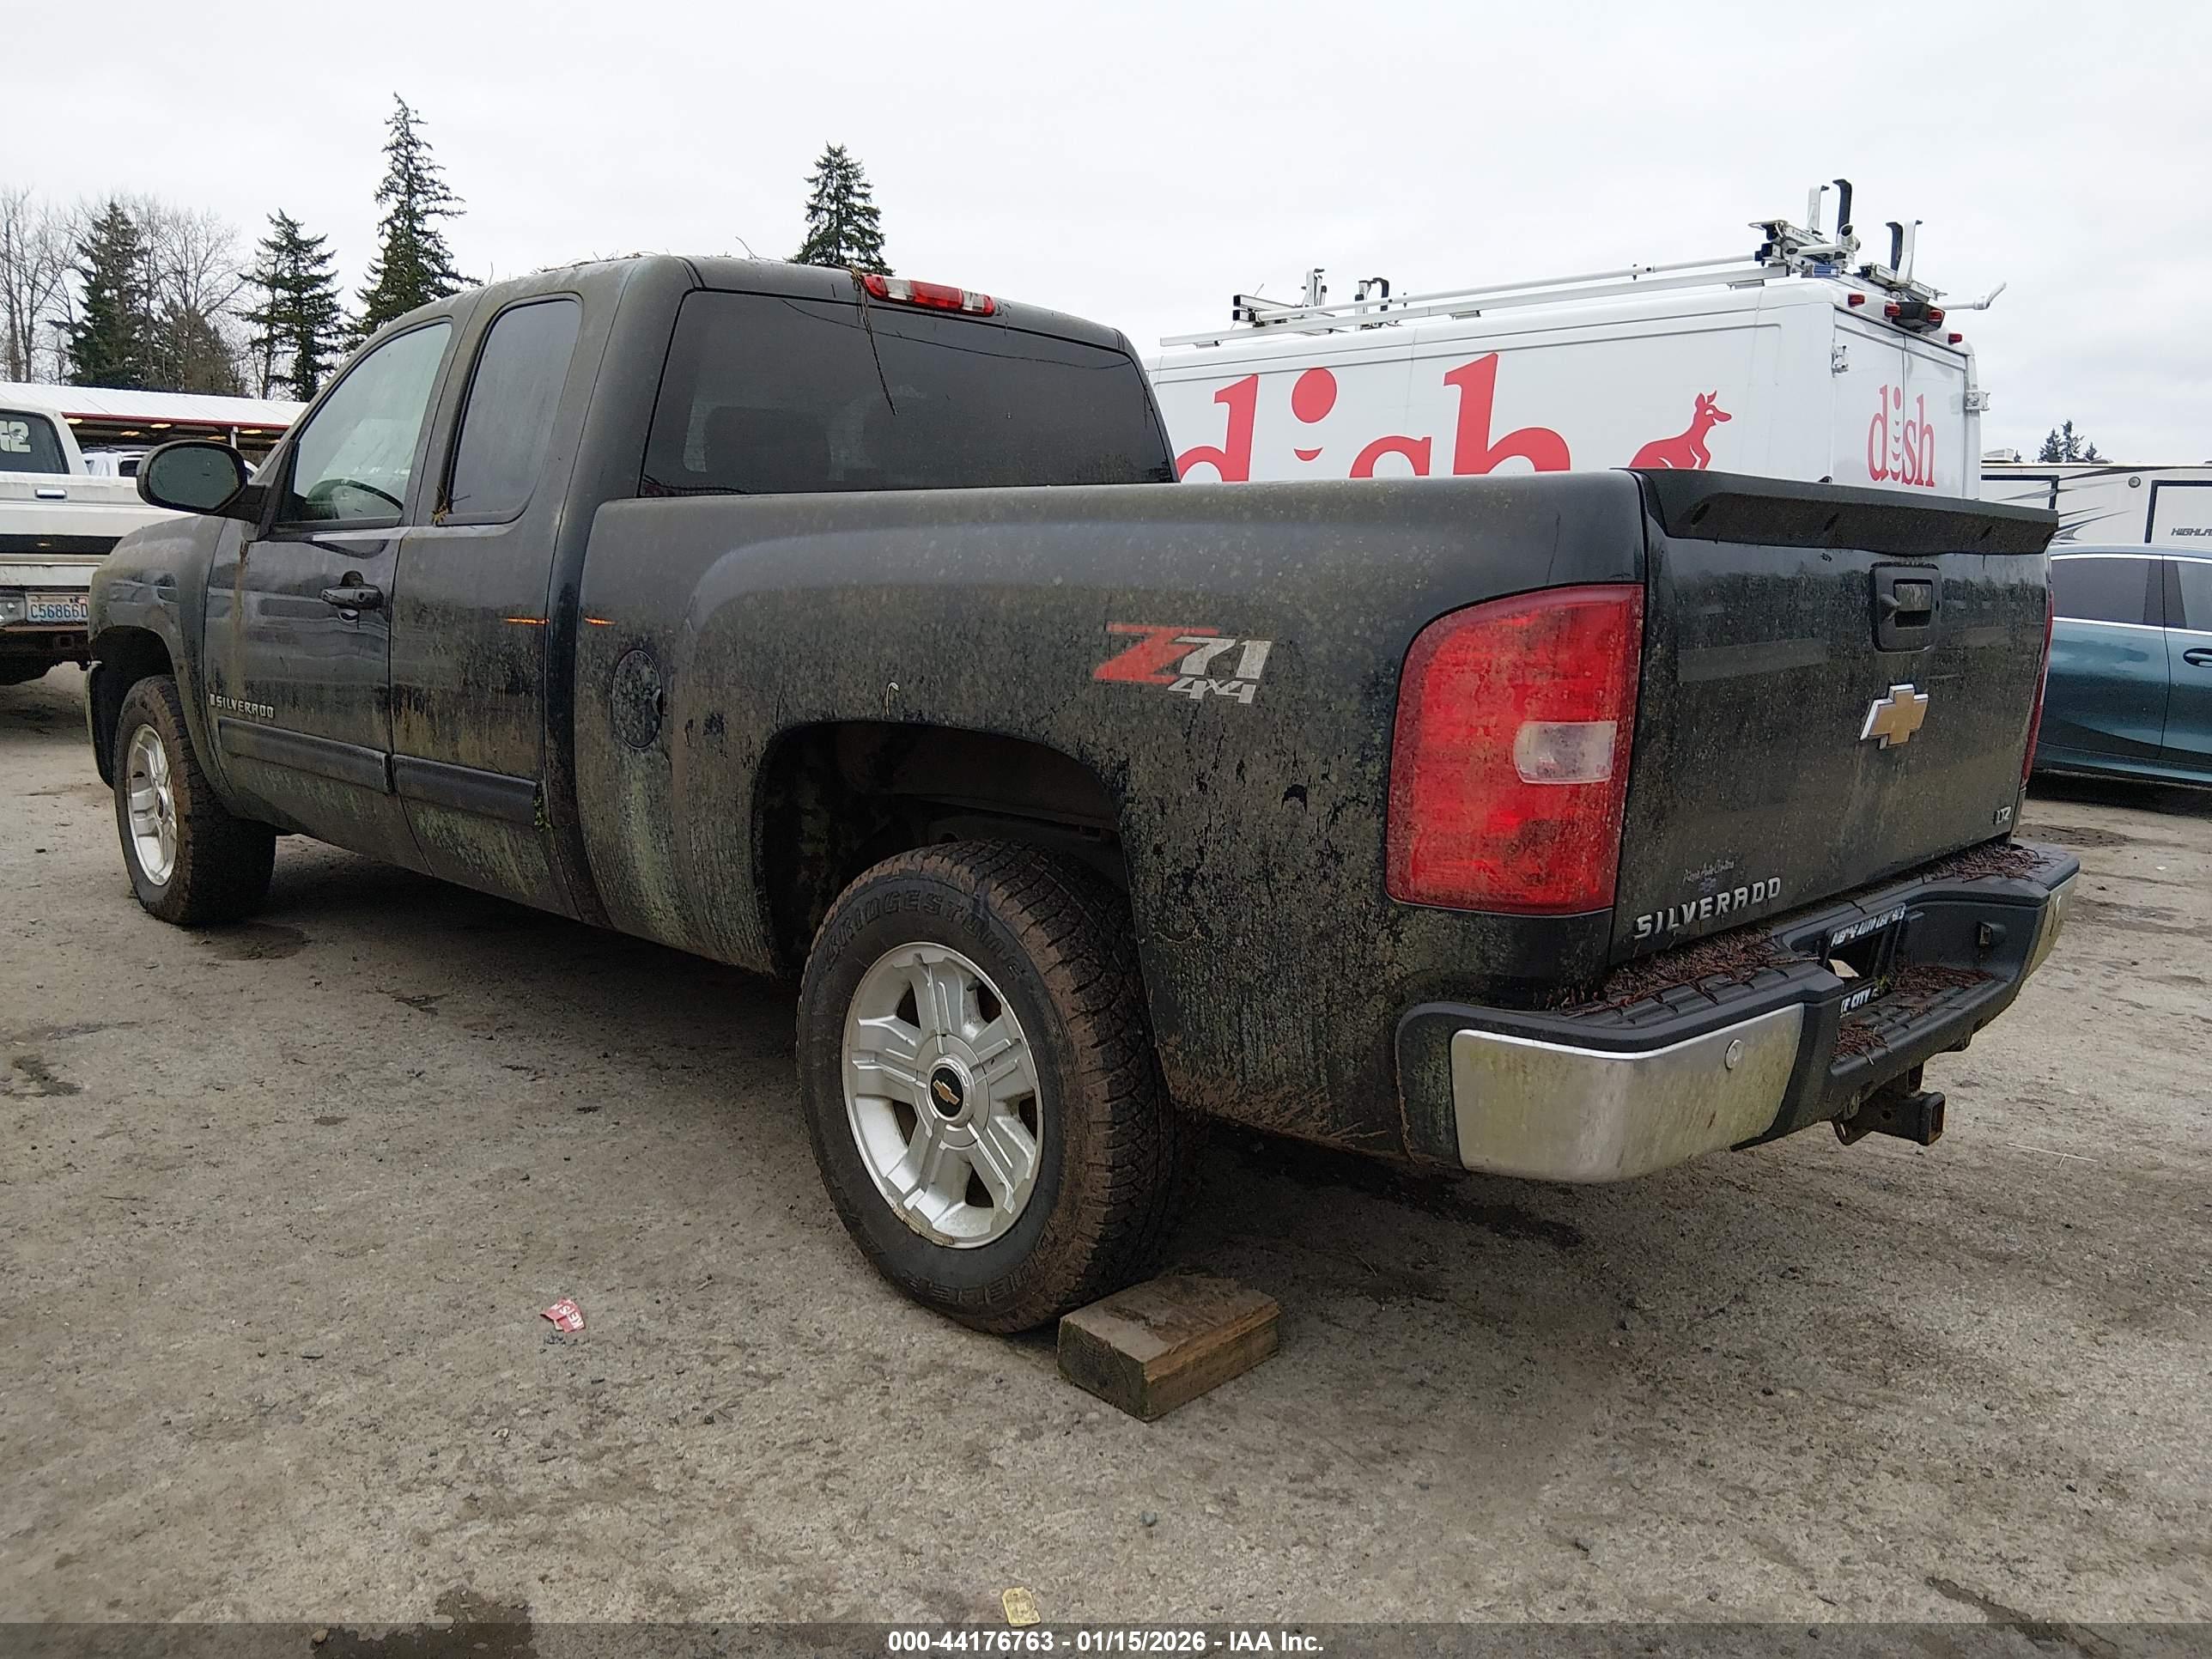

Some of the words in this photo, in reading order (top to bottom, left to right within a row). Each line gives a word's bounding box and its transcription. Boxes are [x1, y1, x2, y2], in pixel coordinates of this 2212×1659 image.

[1868, 384, 1936, 488] dish
[1093, 621, 1273, 684] Z71
[216, 696, 274, 719] SILVERADO
[1994, 806, 2012, 825] LTZ
[1633, 877, 1782, 940] SILVERADO
